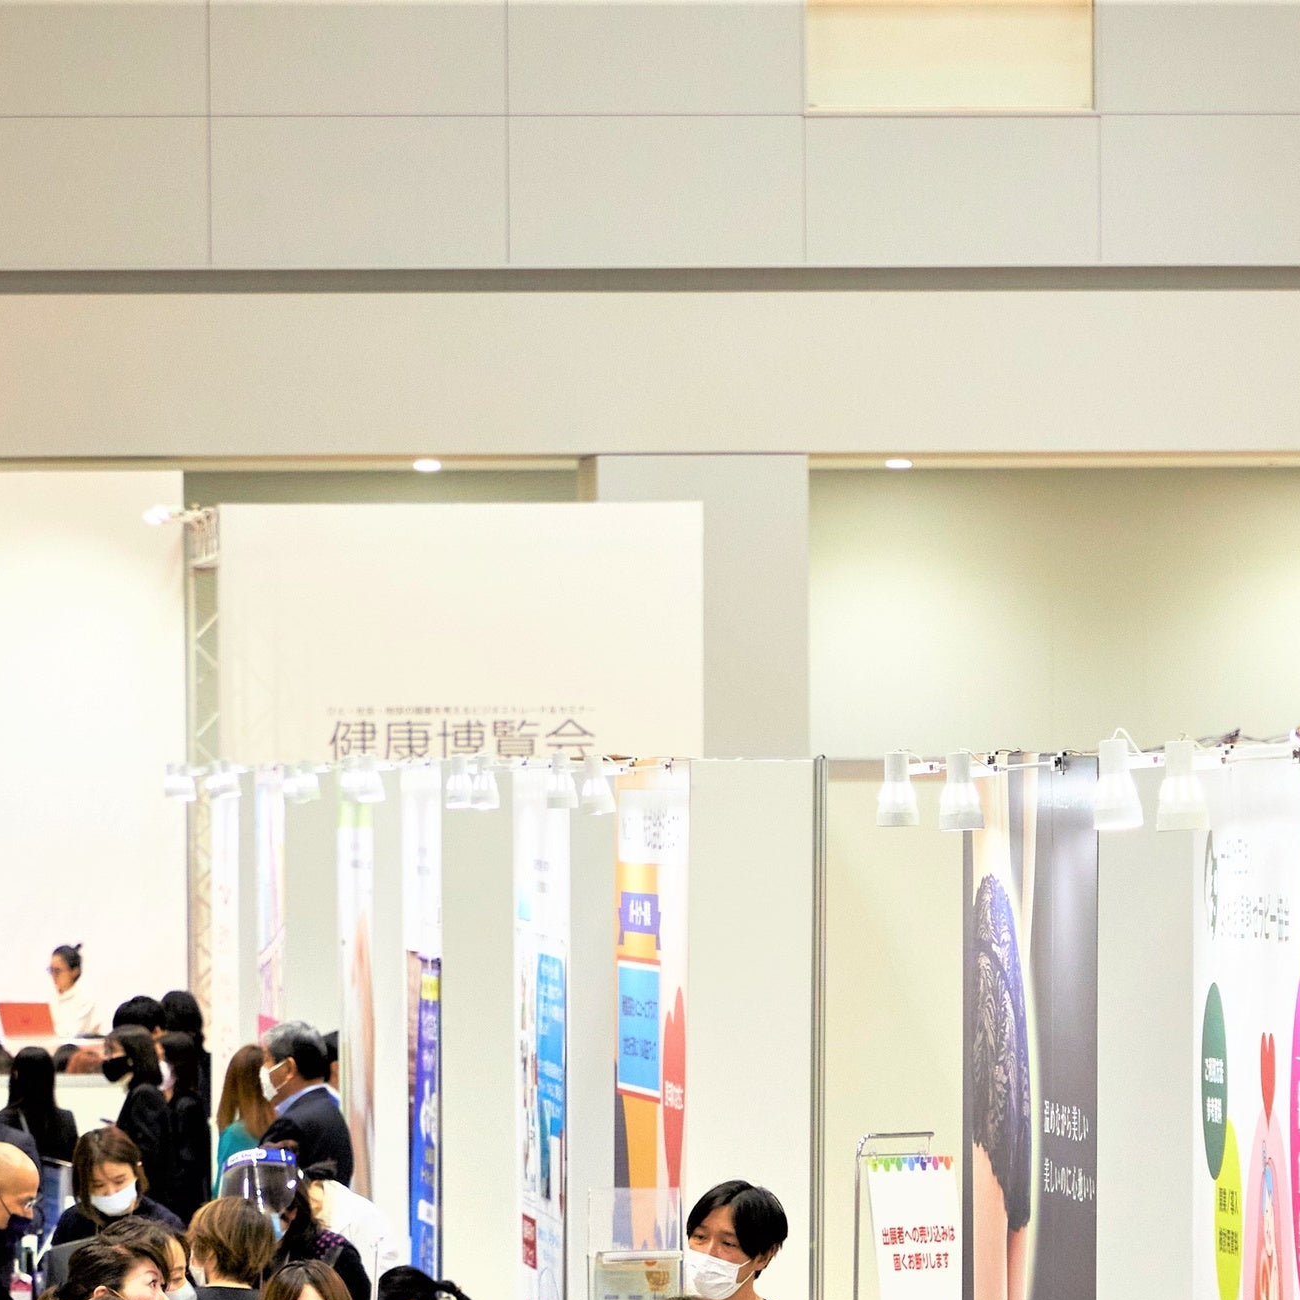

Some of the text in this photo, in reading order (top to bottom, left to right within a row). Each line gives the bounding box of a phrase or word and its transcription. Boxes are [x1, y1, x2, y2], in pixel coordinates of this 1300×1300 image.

[330, 719, 596, 758] 健康博覧会
[1044, 1100, 1089, 1141] 温めながら美しい
[882, 1226, 955, 1245] 出展者への売り込みは
[893, 1253, 948, 1271] 固くお断りします
